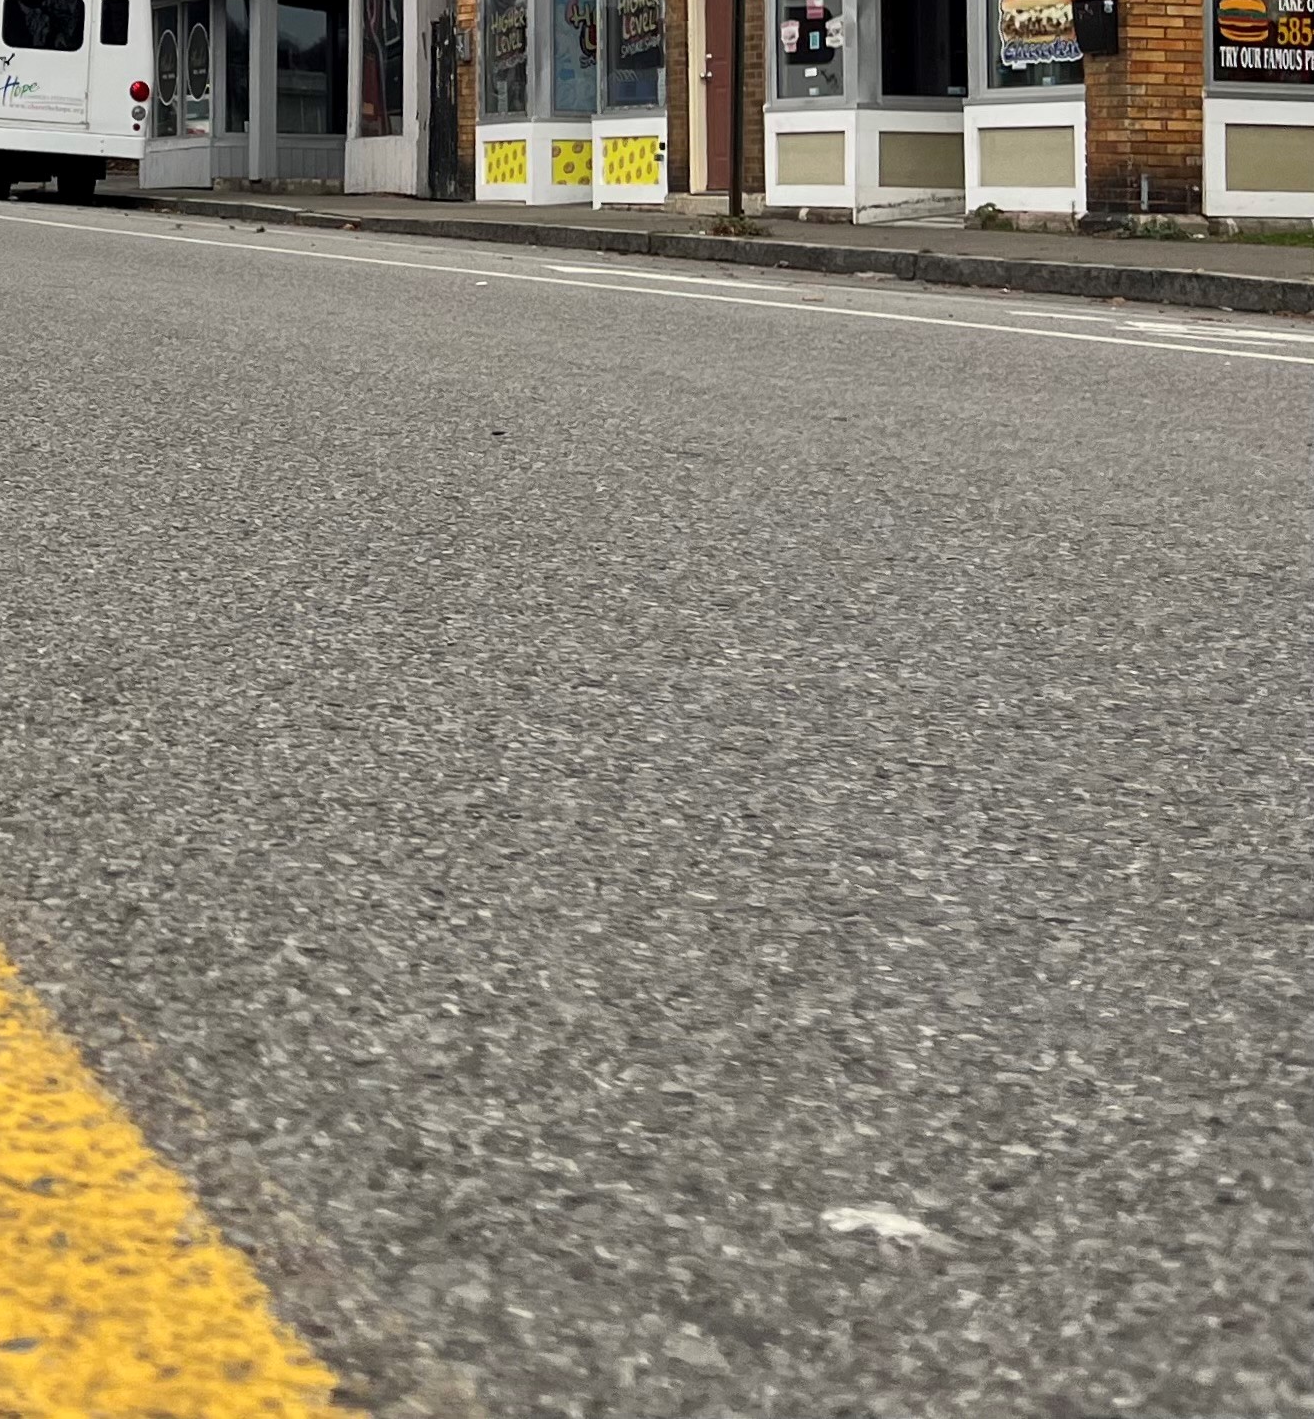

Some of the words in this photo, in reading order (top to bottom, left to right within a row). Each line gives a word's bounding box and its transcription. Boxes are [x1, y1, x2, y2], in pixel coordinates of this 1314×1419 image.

[622, 9, 657, 40] LEVEL
[1277, 17, 1314, 46] 585
[1219, 46, 1239, 68] TRY
[1241, 47, 1261, 69] OUR
[1263, 47, 1303, 71] FAMOUS
